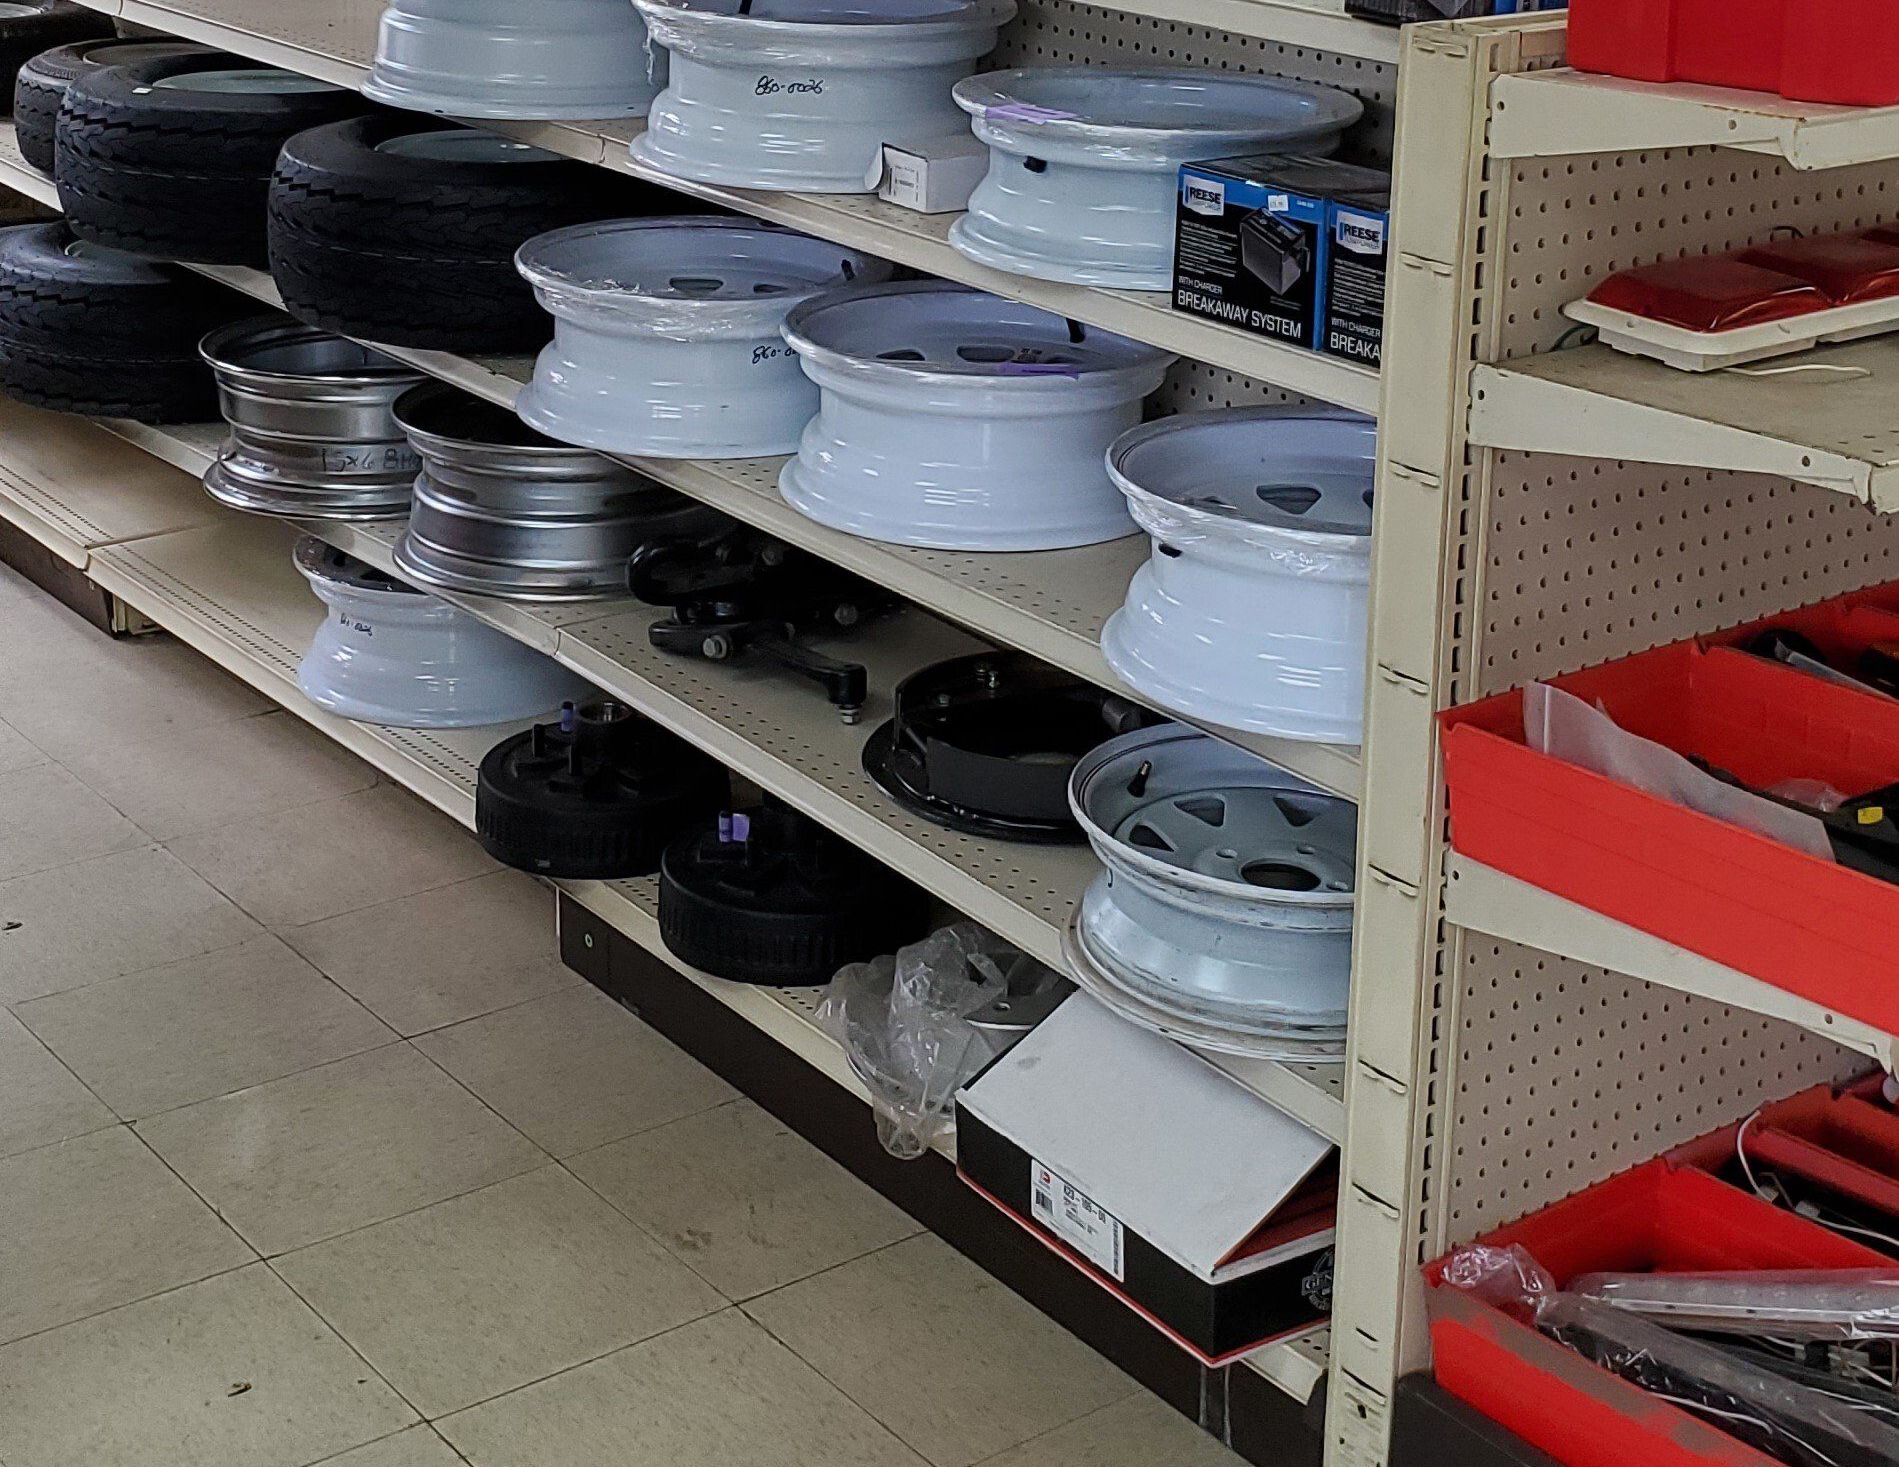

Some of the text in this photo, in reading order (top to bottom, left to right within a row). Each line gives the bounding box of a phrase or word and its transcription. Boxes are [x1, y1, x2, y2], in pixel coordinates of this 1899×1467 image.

[1189, 187, 1222, 205] REESE
[1343, 224, 1381, 243] REESE
[1178, 275, 1193, 286] WITH
[1177, 289, 1301, 339] BREAKAWAY SYSTEM
[1331, 317, 1347, 329] WITH
[1330, 331, 1381, 359] BREAKA
